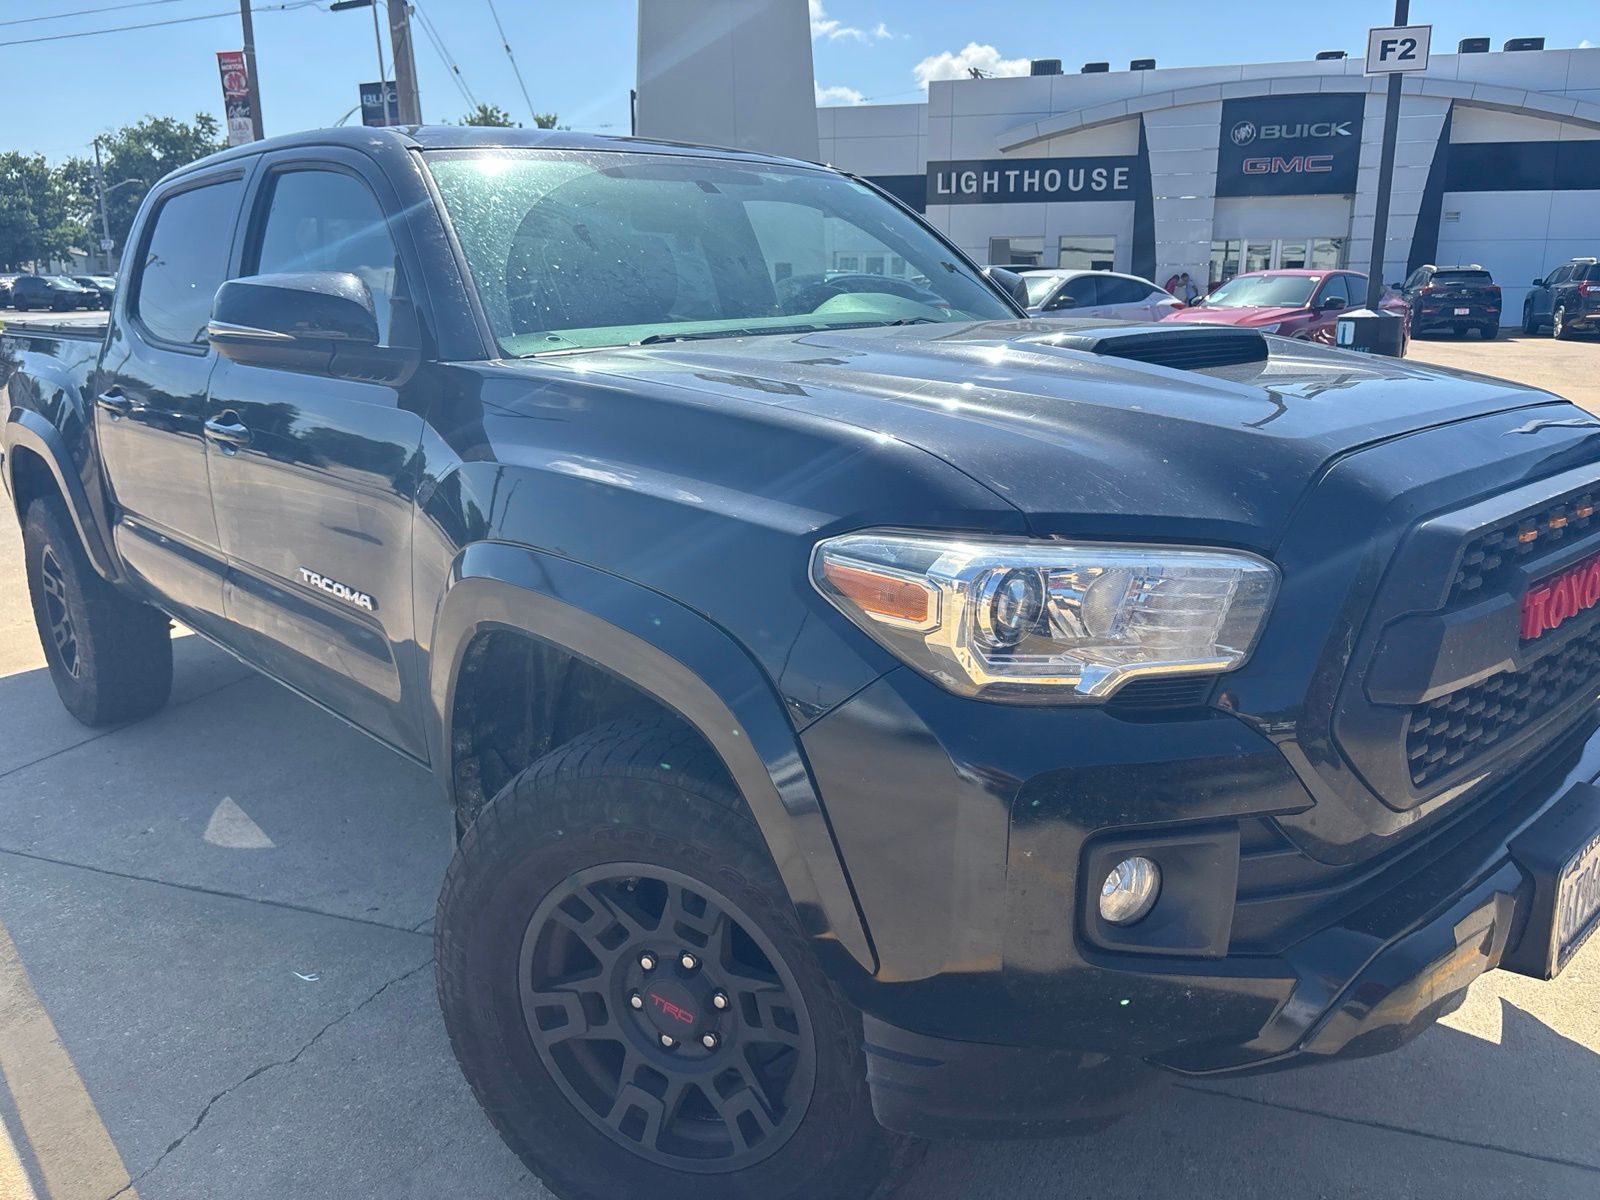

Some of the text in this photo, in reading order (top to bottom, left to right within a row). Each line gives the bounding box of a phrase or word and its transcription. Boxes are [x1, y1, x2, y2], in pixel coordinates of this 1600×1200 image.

[1380, 38, 1417, 61] F2
[362, 92, 398, 104] BUC
[1260, 121, 1352, 139] BUICK
[1242, 155, 1333, 174] GMC
[937, 167, 1129, 194] LIGHTHOUSE
[299, 567, 377, 611] TACOMA
[650, 992, 694, 1024] TRD
